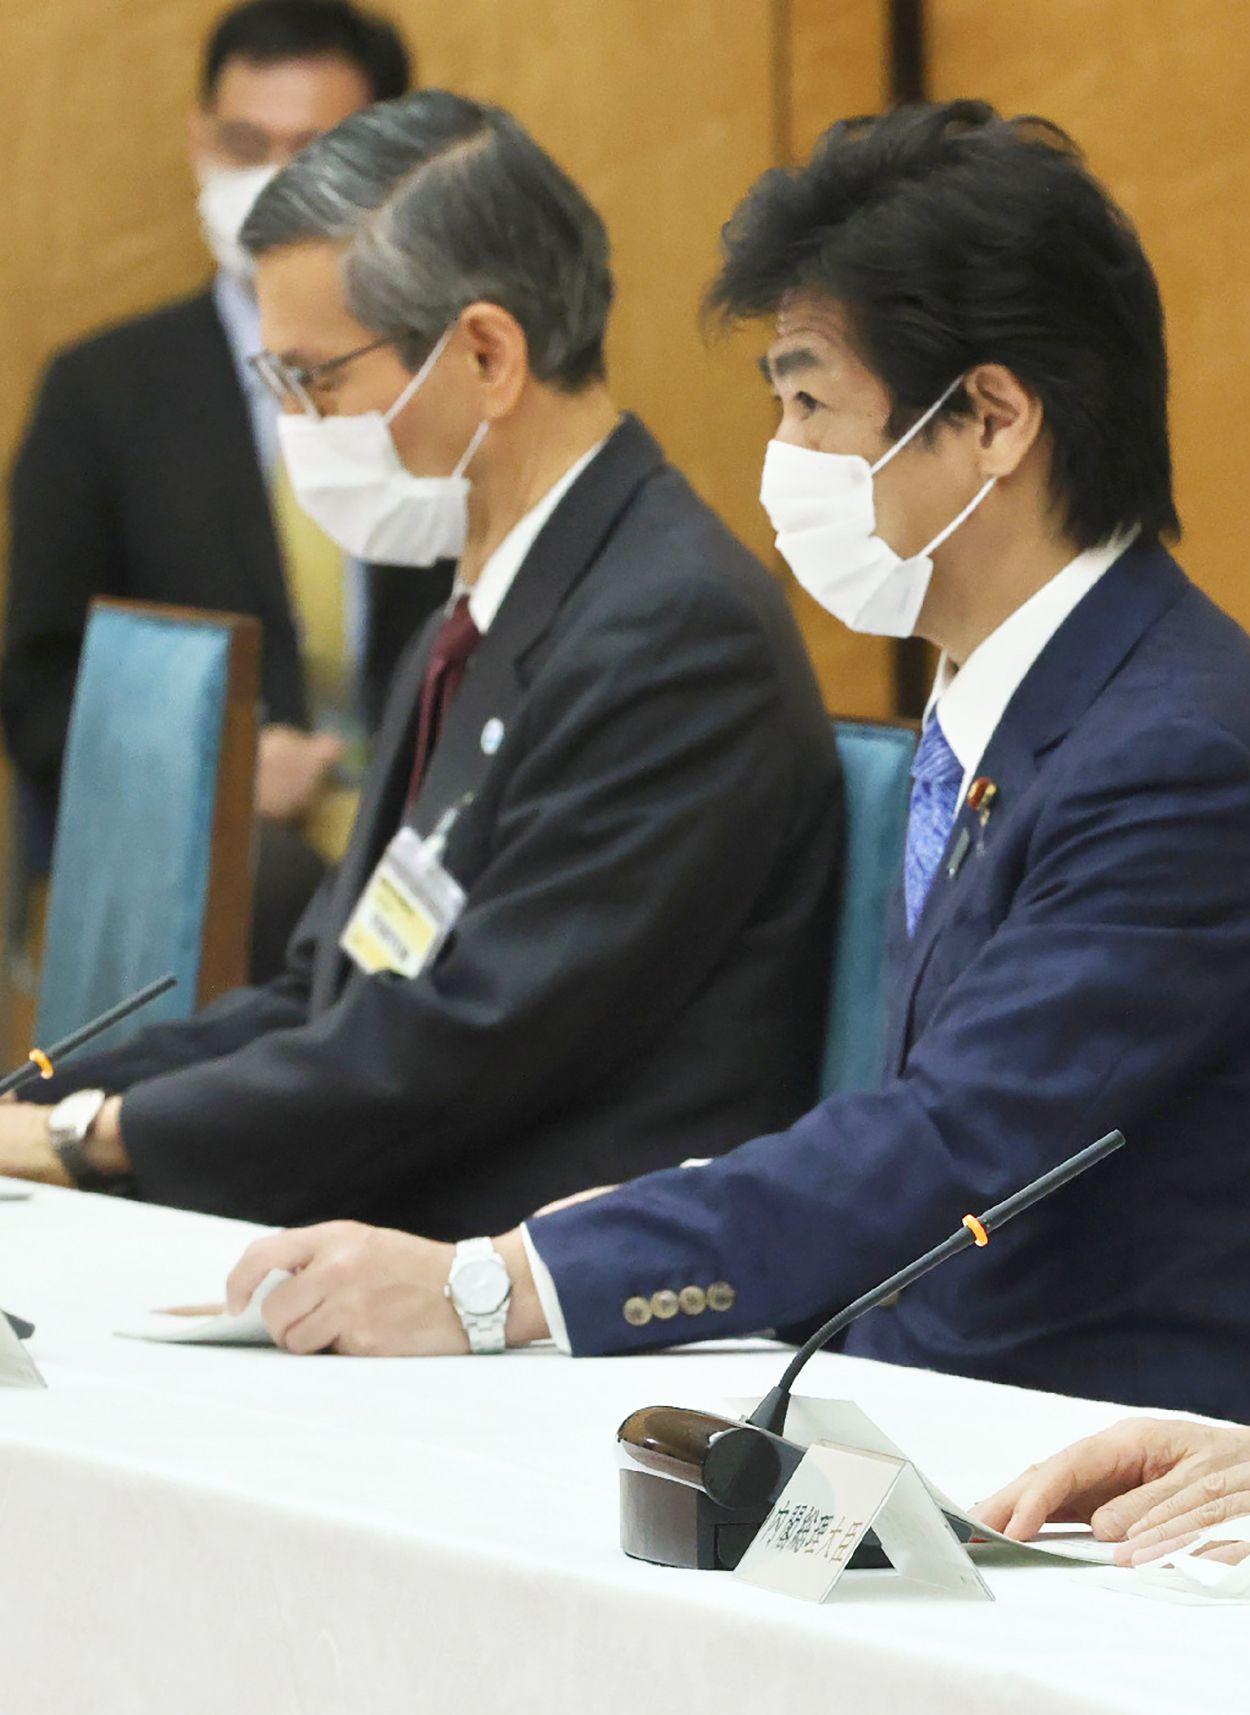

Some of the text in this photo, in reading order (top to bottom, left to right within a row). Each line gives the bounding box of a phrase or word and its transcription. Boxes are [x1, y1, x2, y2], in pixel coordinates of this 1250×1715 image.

[761, 1500, 863, 1562] 内閣総理大臣
